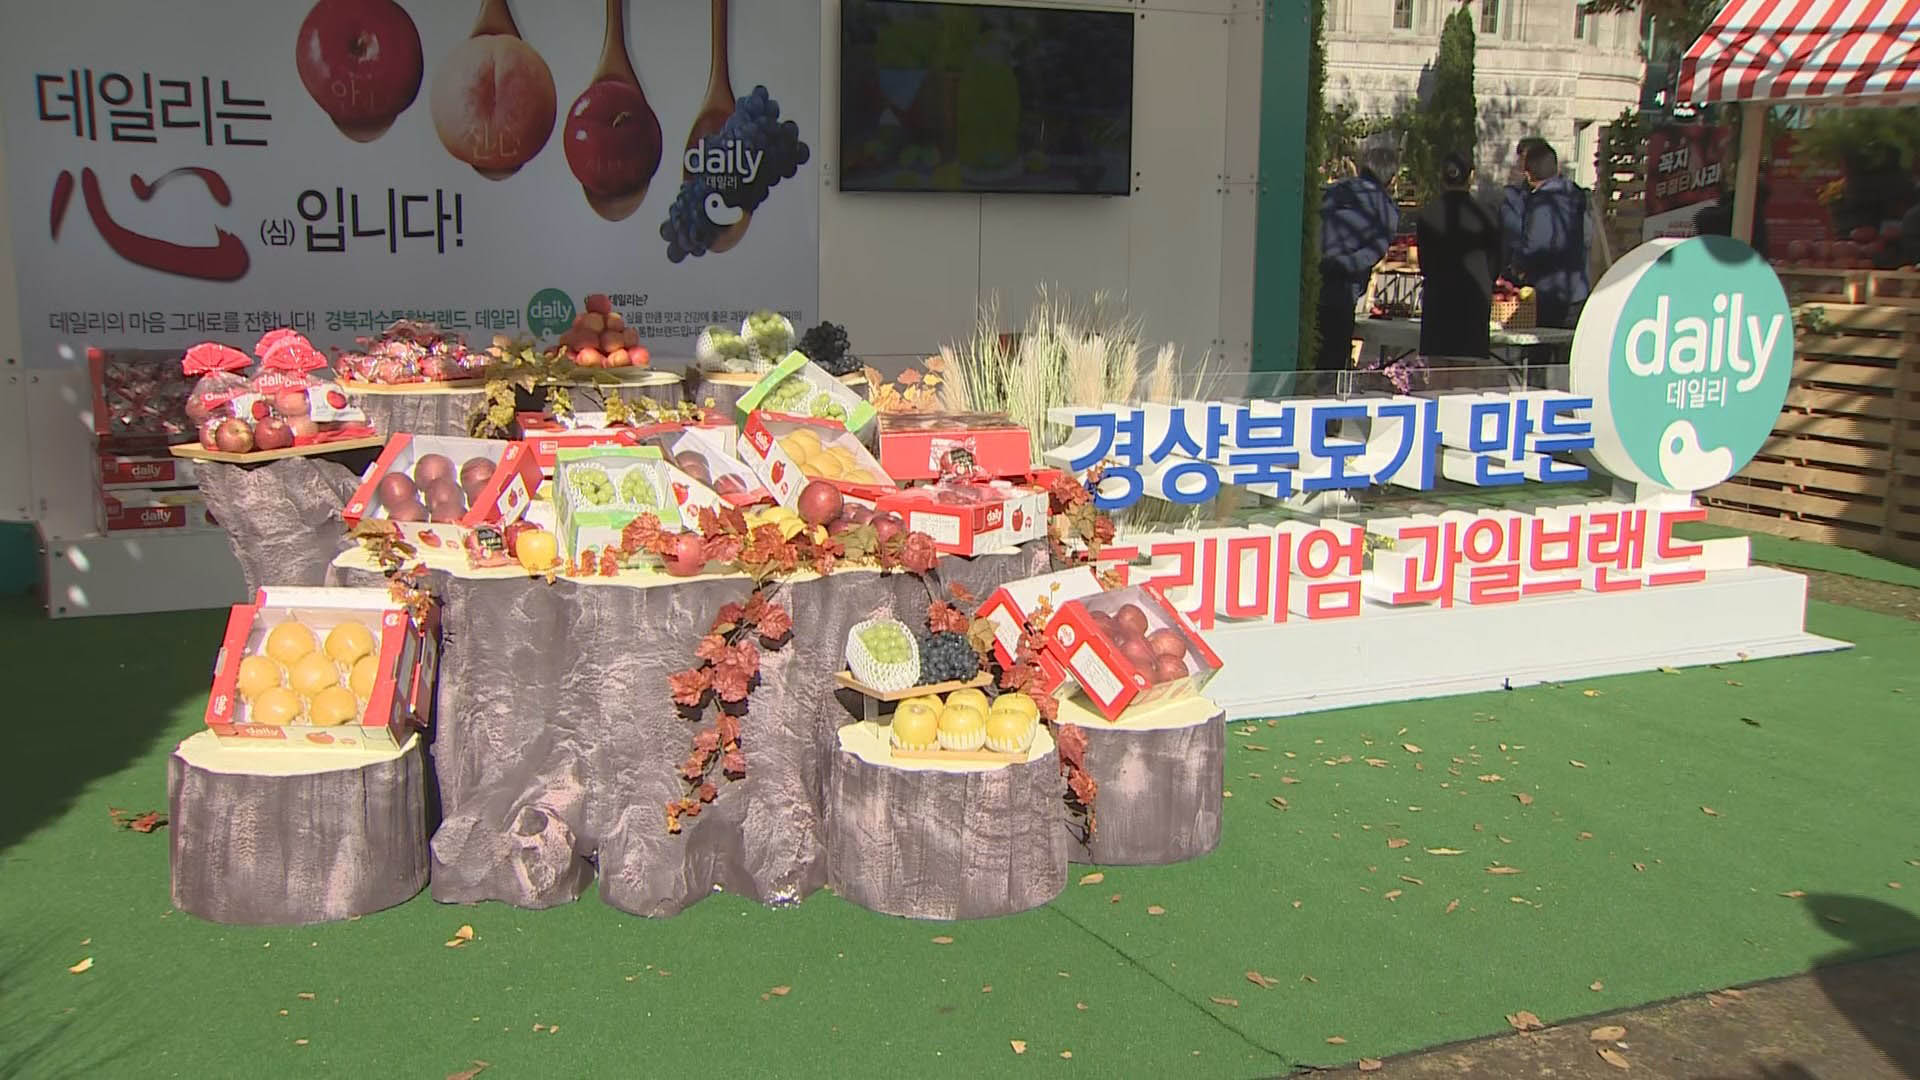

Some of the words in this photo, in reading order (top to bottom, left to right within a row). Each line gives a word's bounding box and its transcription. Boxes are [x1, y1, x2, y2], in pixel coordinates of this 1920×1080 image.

[36, 69, 273, 146] 데일리는
[684, 138, 764, 183] daily
[297, 187, 464, 254] 입니다!
[49, 311, 126, 335] 데일리의
[129, 311, 166, 334] 마음
[170, 312, 240, 333] 그대로를
[244, 311, 315, 333] 전합니다!
[475, 310, 521, 330] 데일리
[530, 300, 572, 321] daily
[1625, 293, 1784, 392] daily
[1666, 376, 1728, 409] 데일리
[131, 463, 161, 477] daily
[1071, 399, 1443, 510] 경상북도가
[1469, 398, 1595, 487] 만든
[140, 509, 172, 523] daily
[1078, 527, 1365, 630] 리미엄
[1392, 508, 1708, 609] 과일브랜드
